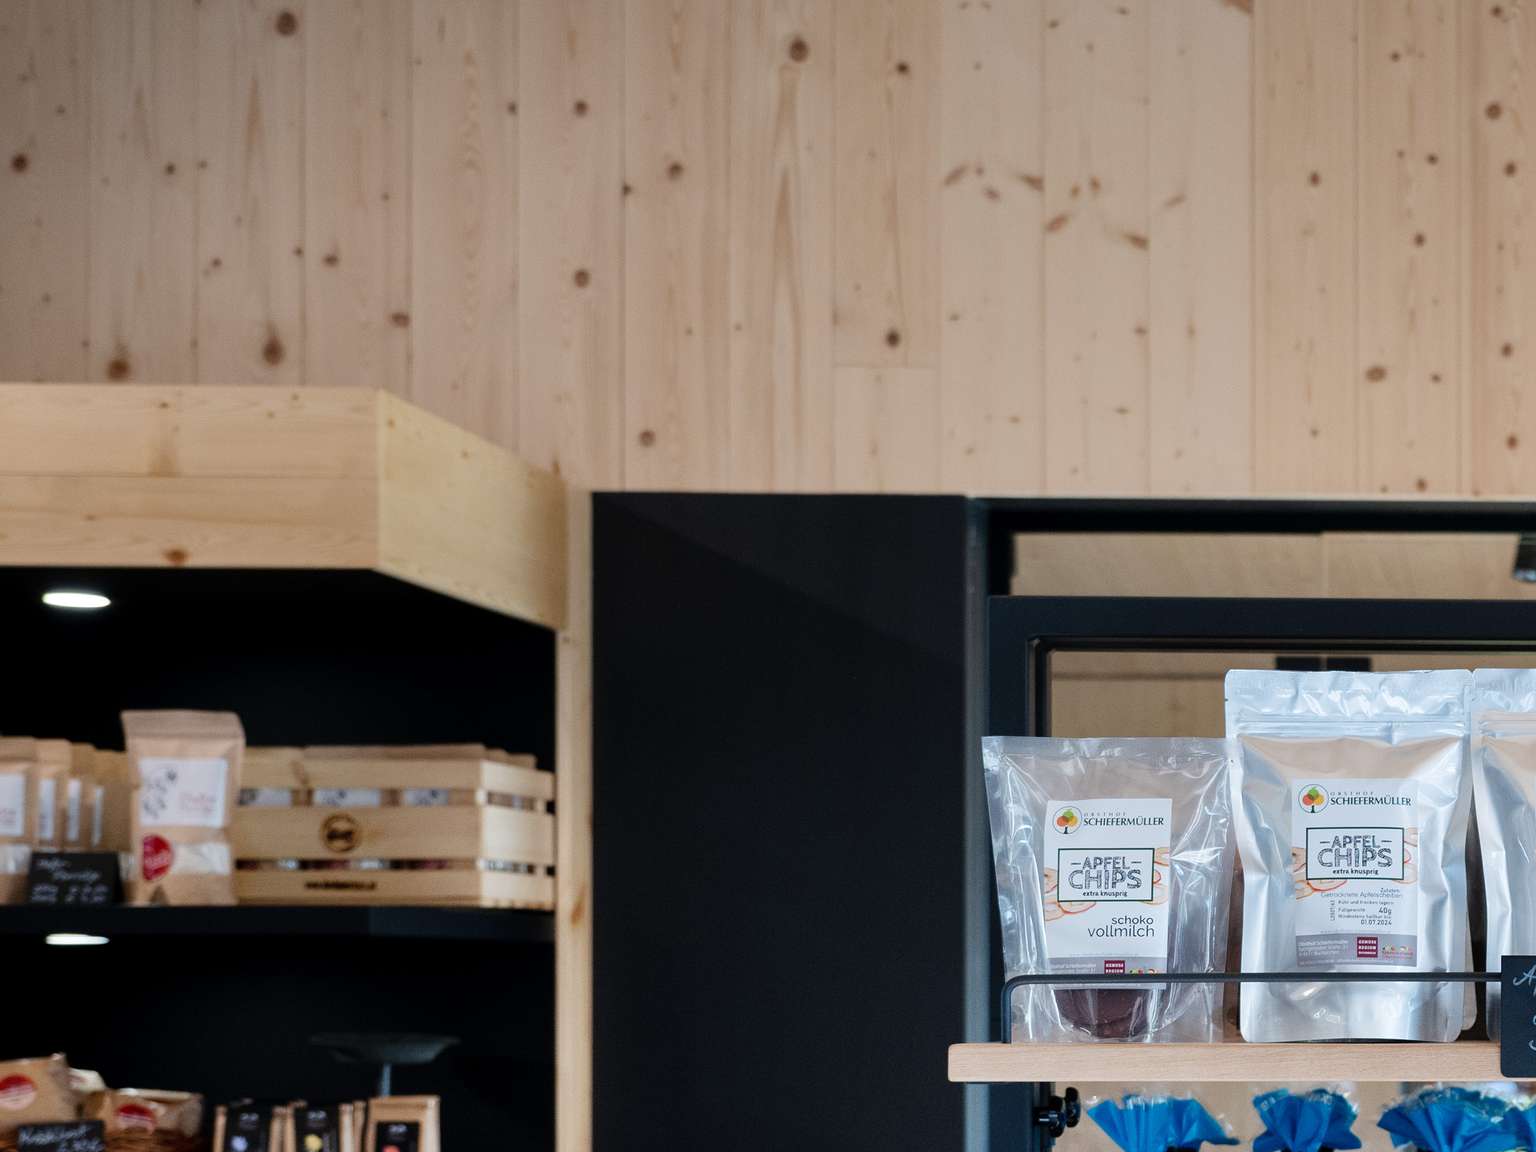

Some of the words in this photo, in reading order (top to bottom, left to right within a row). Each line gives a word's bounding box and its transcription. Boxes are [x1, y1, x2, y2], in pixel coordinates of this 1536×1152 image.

[1330, 795, 1411, 806] SCHIEFERMÜLLER
[1084, 816, 1164, 825] SCHIEFERMÜLLER
[1332, 835, 1380, 848] APFEL
[1083, 857, 1130, 869] APFEL
[1318, 848, 1392, 867] CHIPS
[1069, 870, 1142, 889] CHIPS
[1379, 907, 1392, 915] 40g
[1112, 916, 1153, 925] schoko
[1088, 926, 1154, 937] vollmilch
